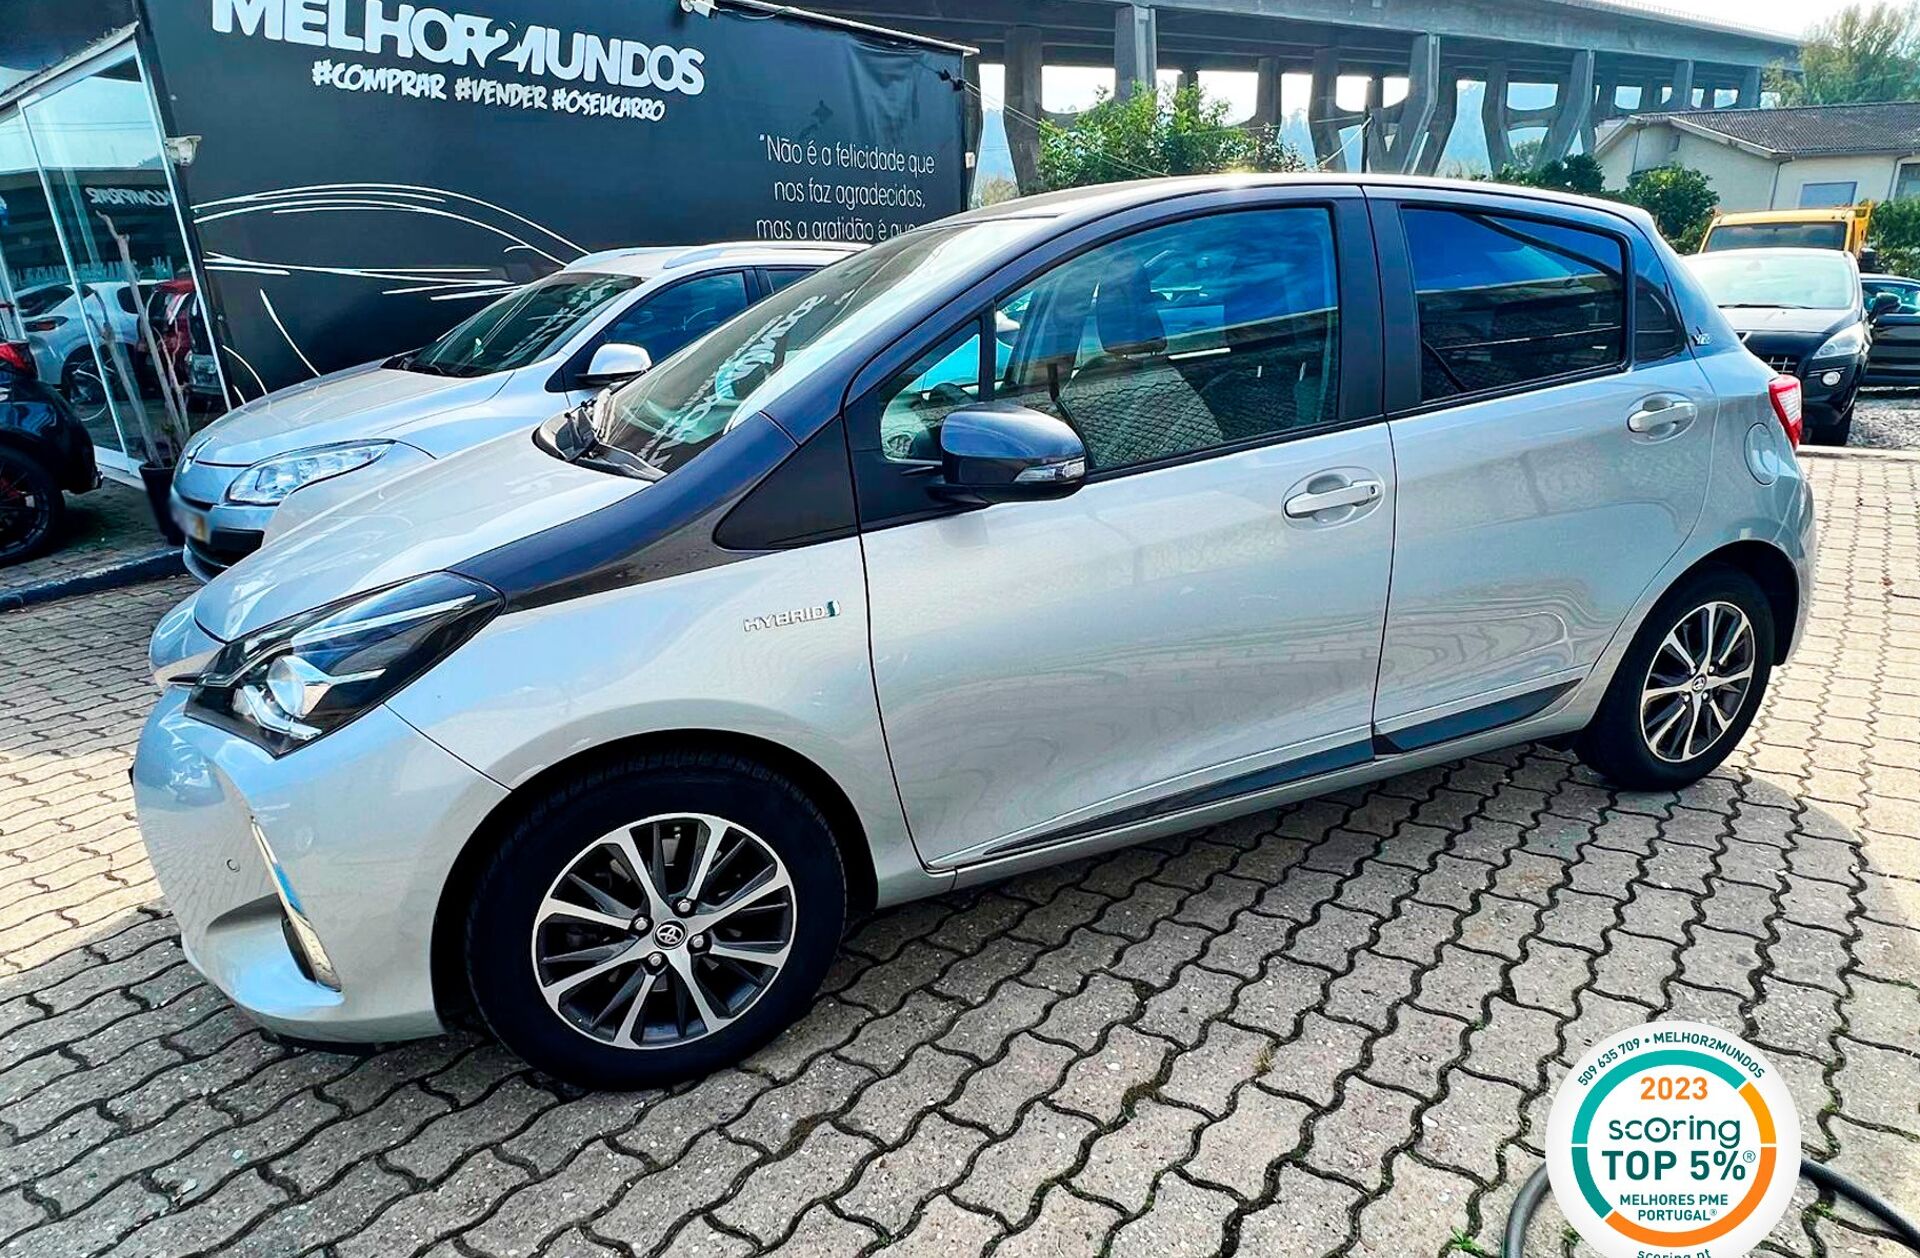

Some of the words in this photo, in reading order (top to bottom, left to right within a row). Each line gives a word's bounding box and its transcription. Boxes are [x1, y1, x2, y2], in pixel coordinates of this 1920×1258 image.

[311, 59, 447, 101] #COMPRAR
[454, 77, 548, 111] #VENDER
[807, 139, 817, 166] é
[821, 148, 832, 166] a
[836, 141, 905, 173] felicidade
[908, 153, 935, 178] que
[774, 180, 805, 202] nos
[808, 177, 832, 204] faz
[835, 183, 926, 211] agradecidos,
[756, 219, 793, 240] mas
[797, 220, 807, 240] a
[877, 218, 887, 241] é
[743, 605, 826, 632] HYBRID
